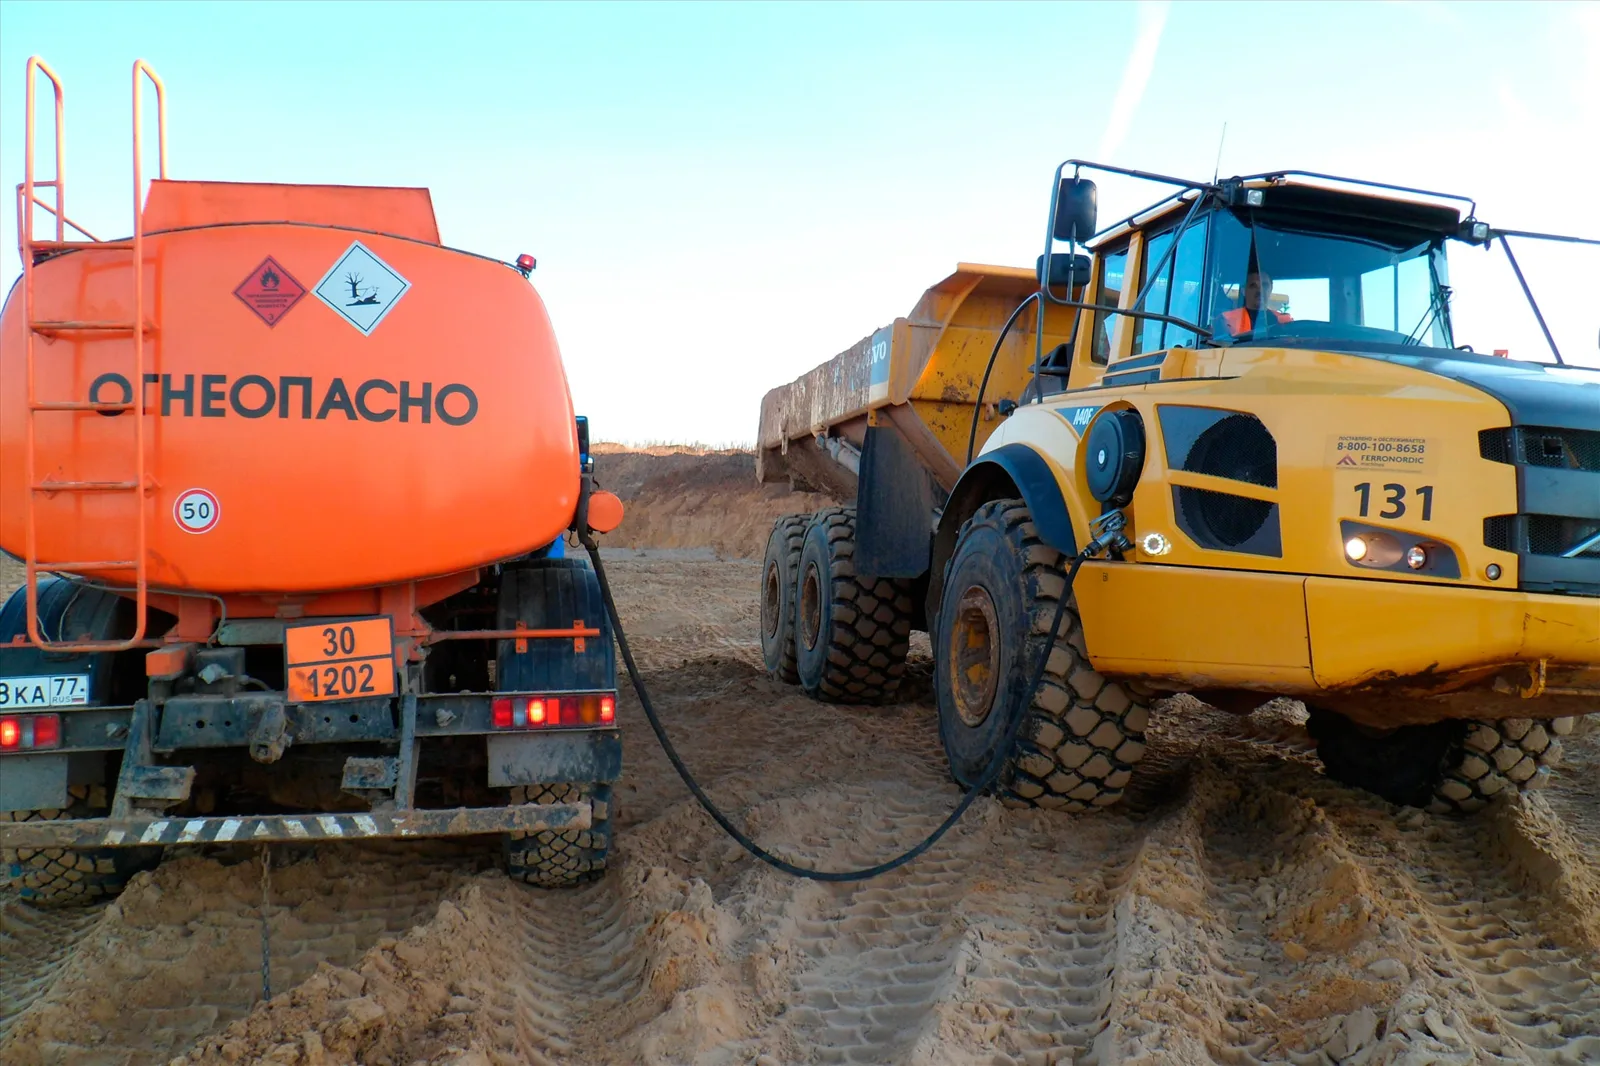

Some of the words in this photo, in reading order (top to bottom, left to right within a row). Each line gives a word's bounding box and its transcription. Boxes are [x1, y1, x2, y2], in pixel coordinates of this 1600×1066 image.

[268, 313, 274, 321] 3
[88, 372, 479, 427] ОГНЕОПАСНО
[1073, 408, 1094, 425] A40F
[1337, 442, 1425, 453] 8-800-100-8658
[1360, 455, 1424, 464] FERRONORDIC
[1353, 482, 1434, 521] 131
[183, 502, 210, 520] 50
[322, 626, 355, 657] 30
[307, 663, 375, 698] 1202
[52, 695, 71, 703] RUS
